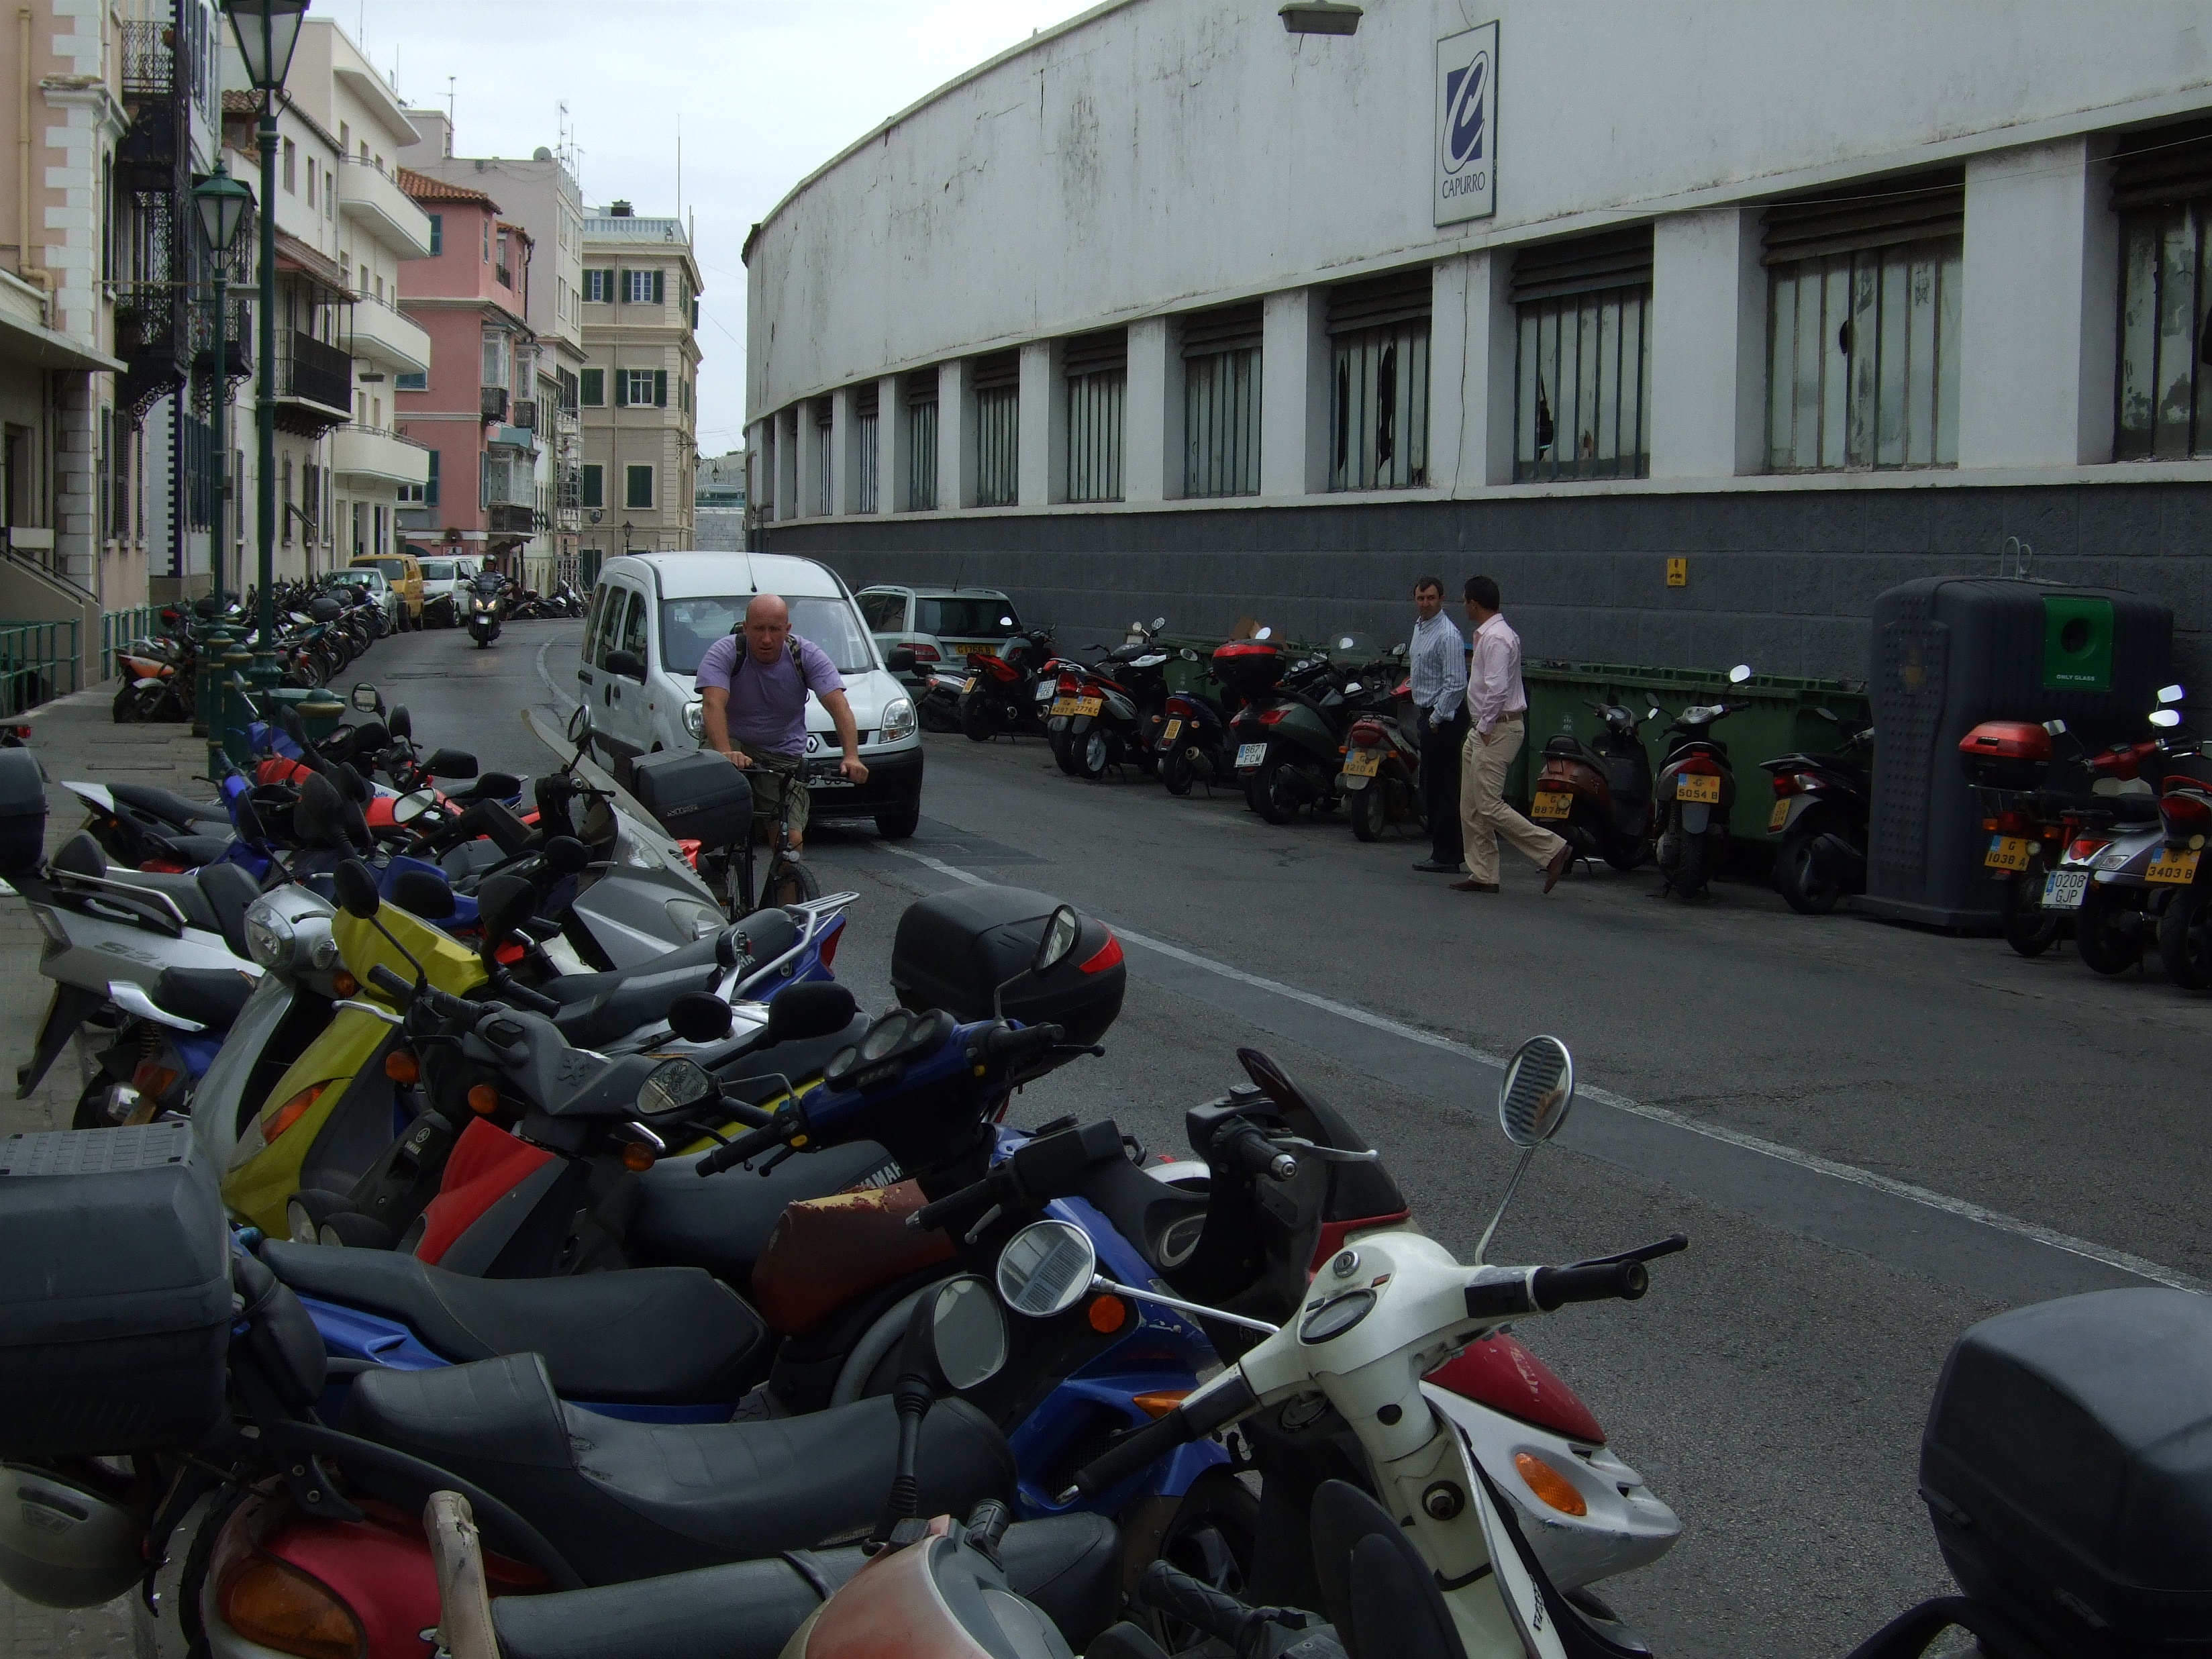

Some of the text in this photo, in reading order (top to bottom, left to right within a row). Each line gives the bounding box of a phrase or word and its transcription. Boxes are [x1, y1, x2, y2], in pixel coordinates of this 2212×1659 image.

[1442, 171, 1485, 199] CAPURRO
[1245, 745, 1264, 754] 8671
[1244, 754, 1261, 763] FCM
[1679, 789, 1707, 799] 5054
[2009, 841, 2016, 850] G
[1989, 853, 2027, 866] 1038 A
[2148, 866, 2193, 878] 3403 B
[2056, 874, 2085, 888] 0208
[2056, 890, 2078, 903] GJP
